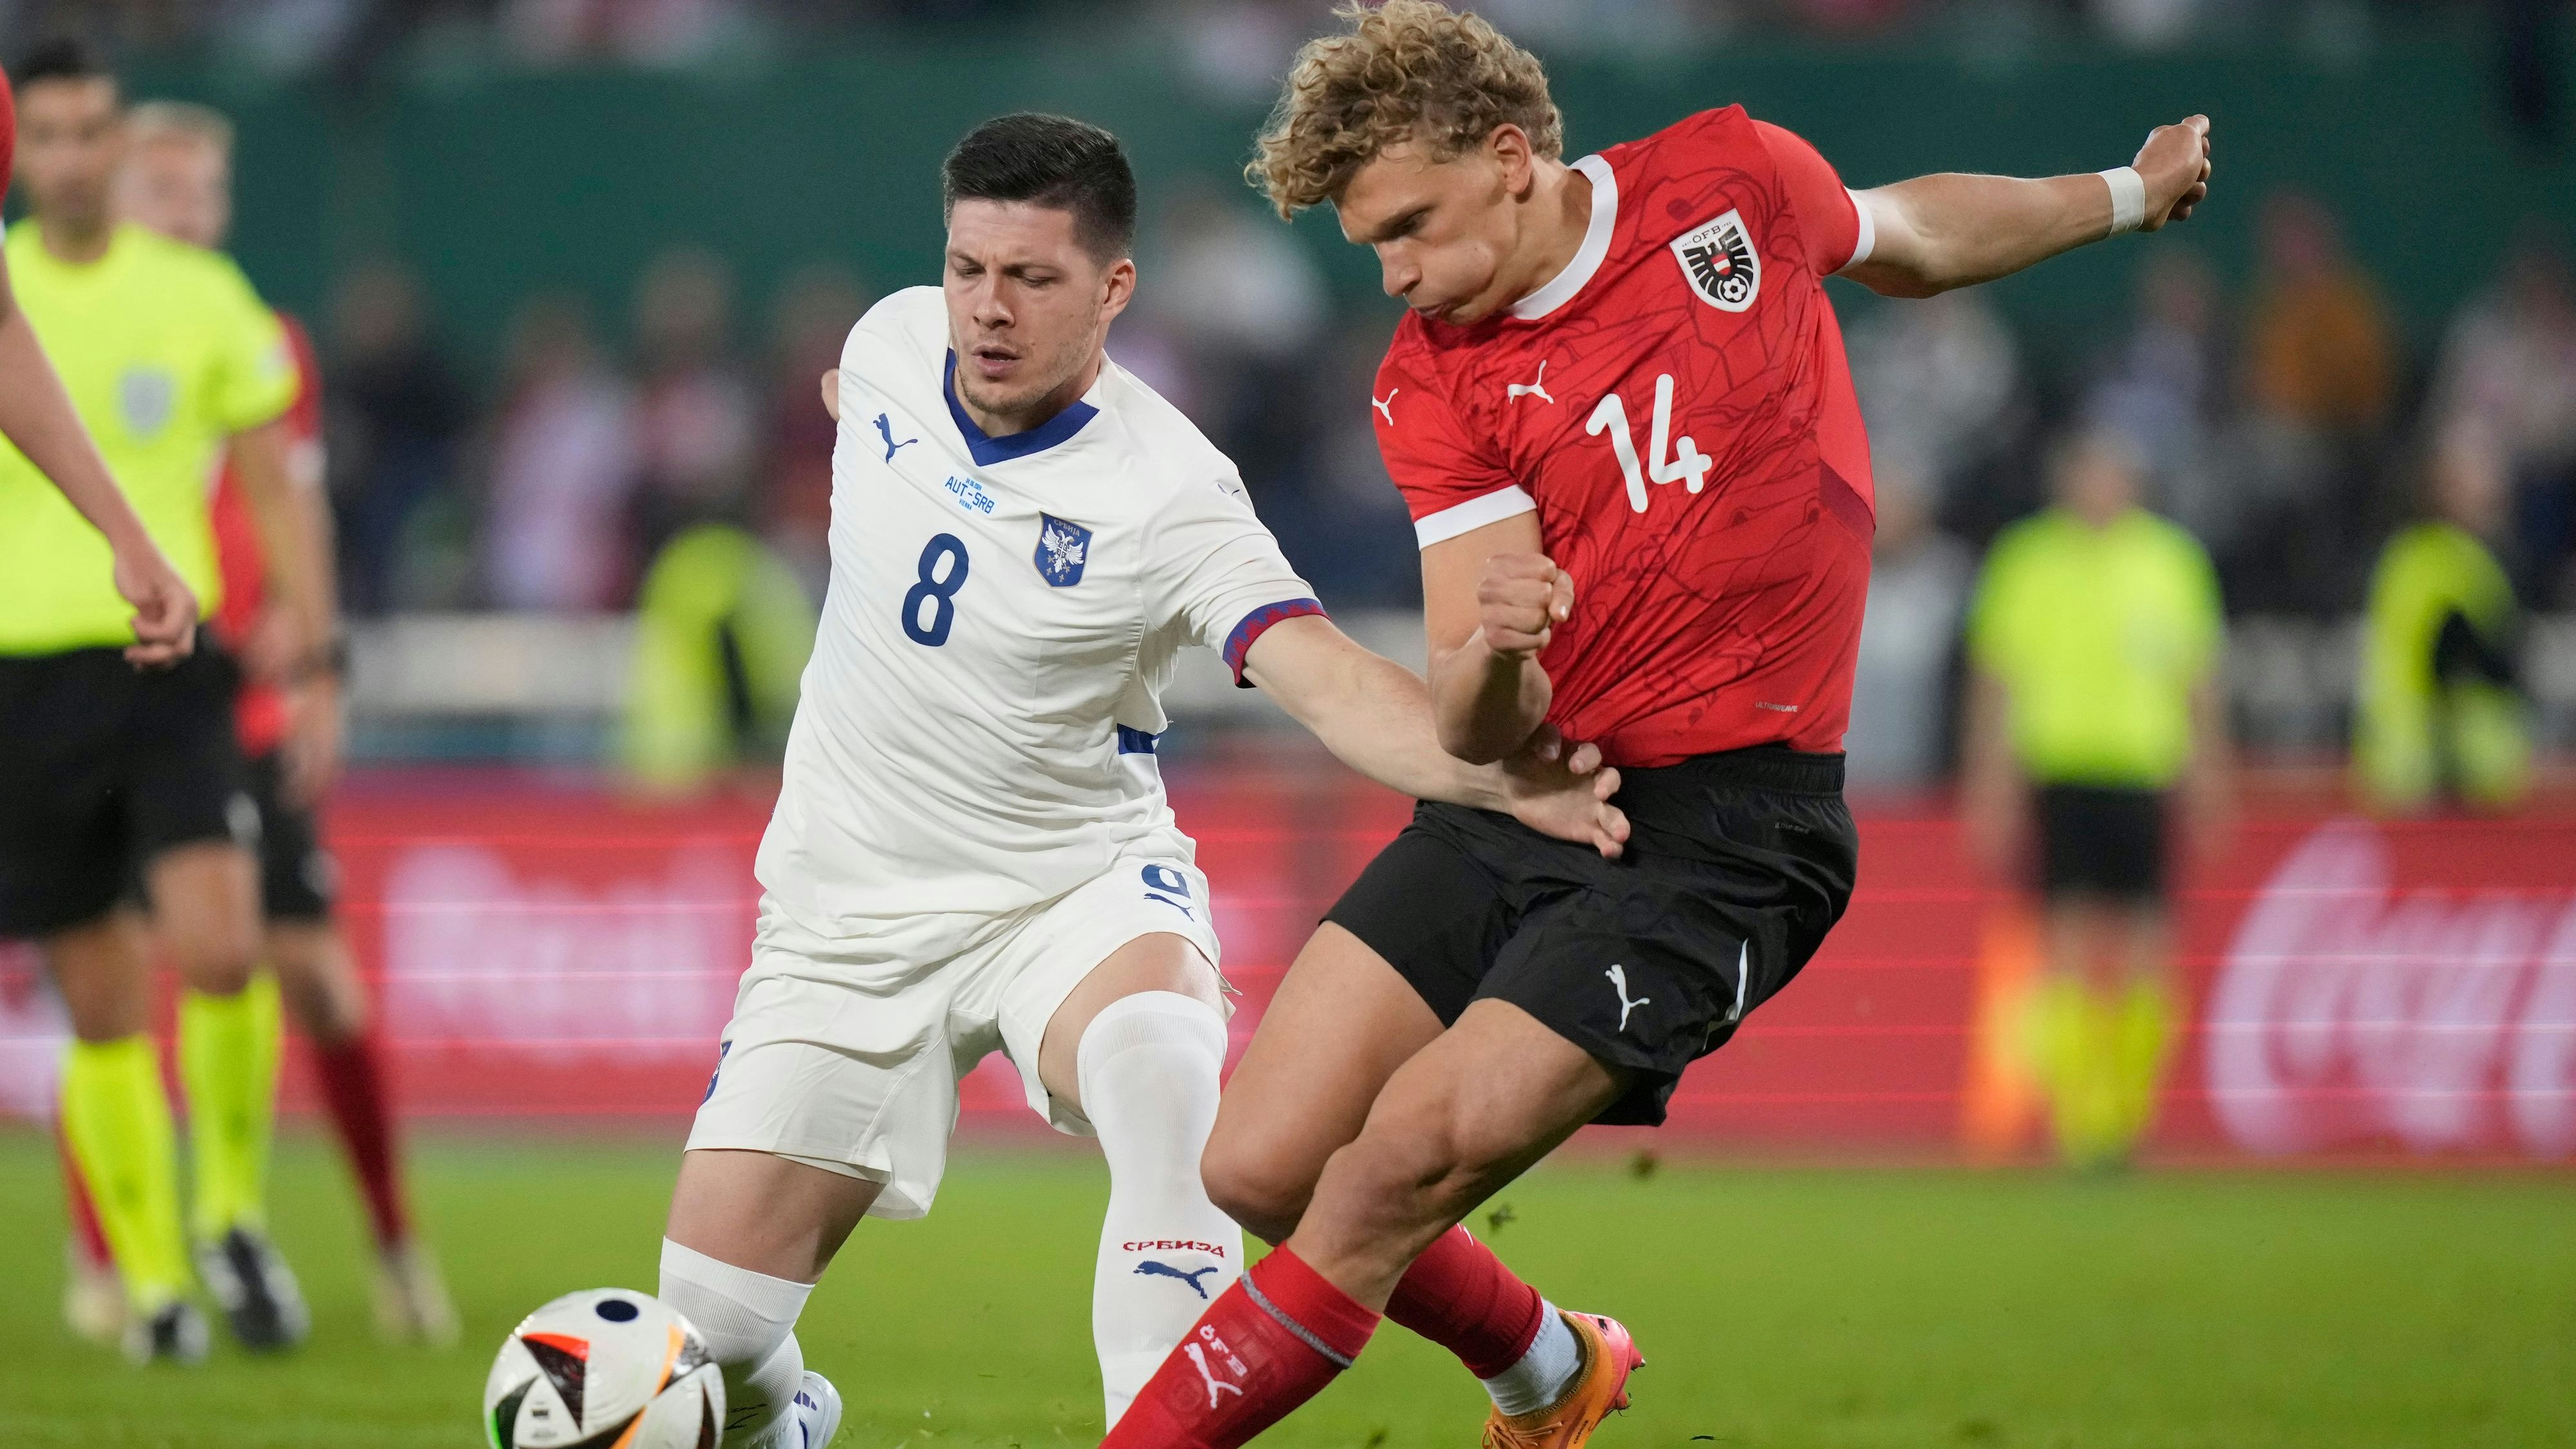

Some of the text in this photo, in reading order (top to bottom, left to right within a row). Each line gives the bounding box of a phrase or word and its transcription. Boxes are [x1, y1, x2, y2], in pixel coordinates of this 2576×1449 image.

[1692, 225, 1721, 243] ÖFB
[1585, 373, 1713, 513] 14
[902, 533, 969, 647] 8
[1199, 1323, 1248, 1378] ÖFB
